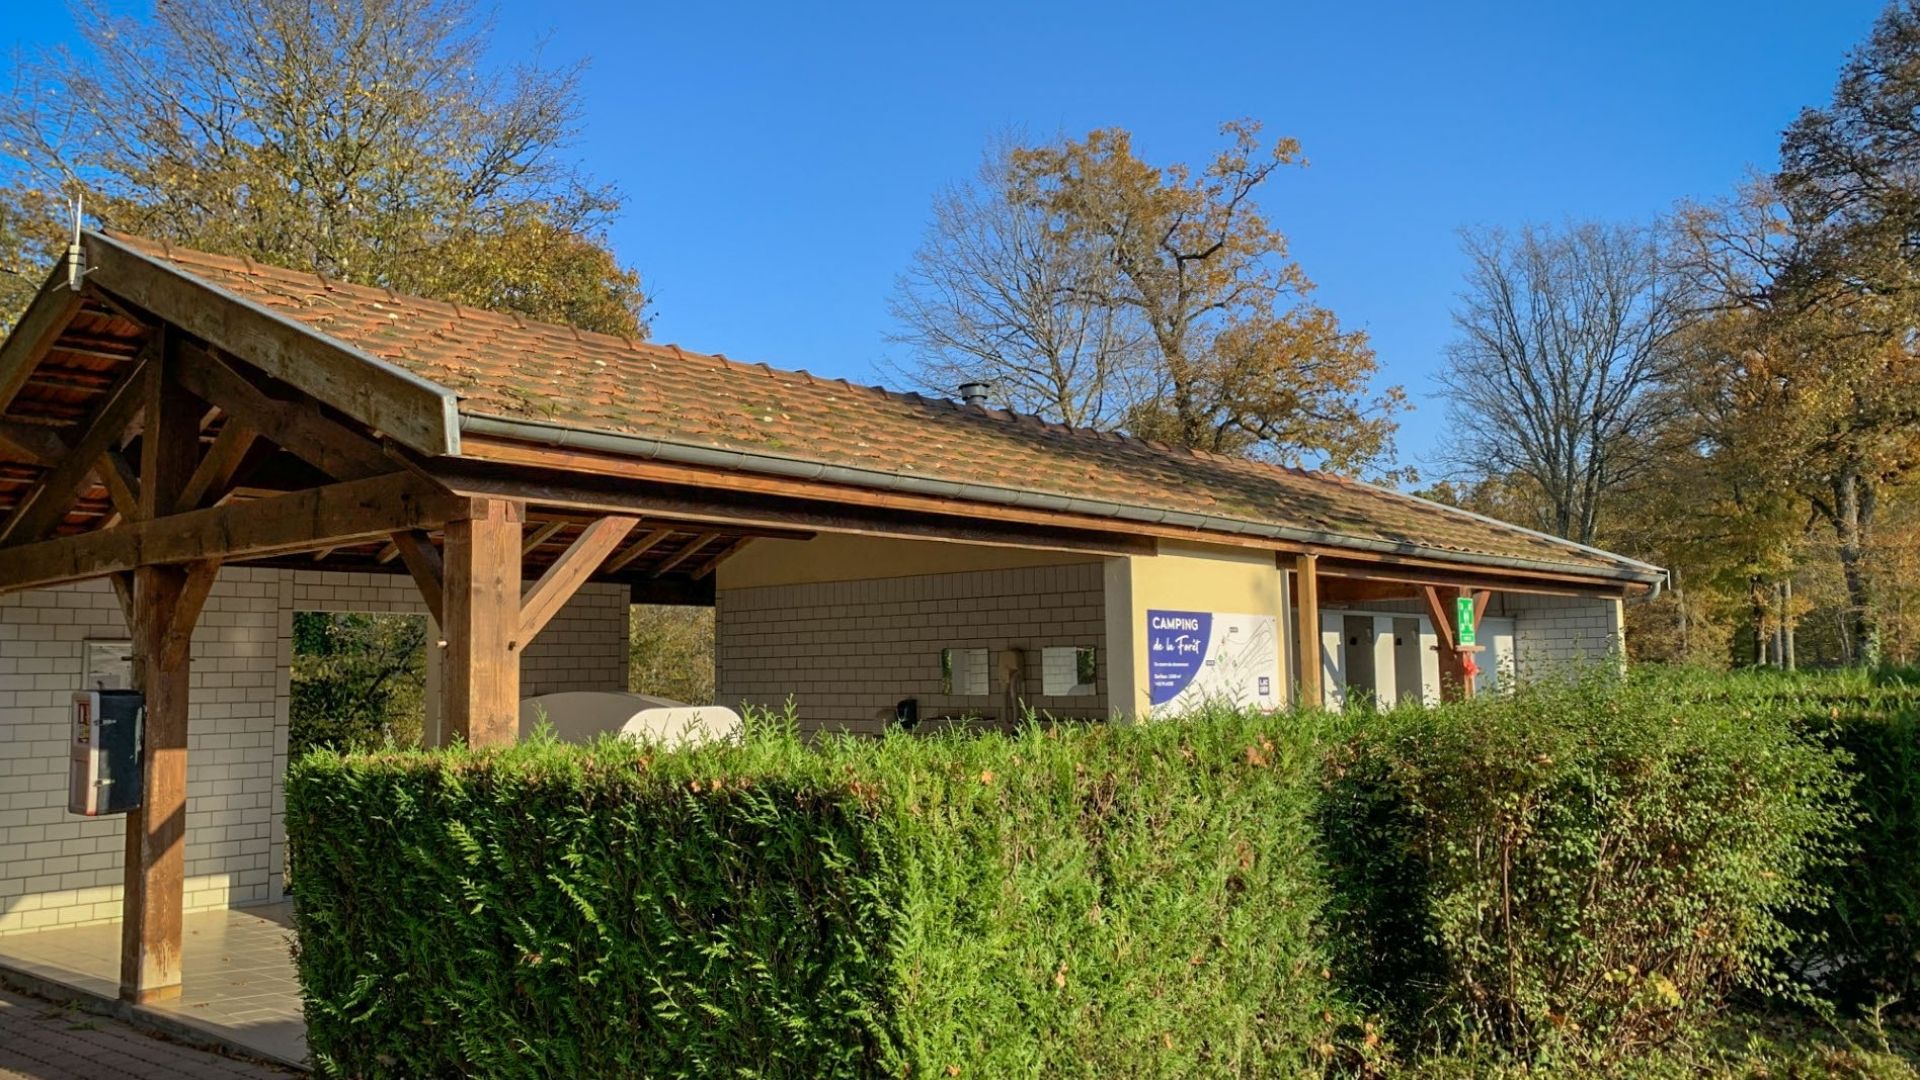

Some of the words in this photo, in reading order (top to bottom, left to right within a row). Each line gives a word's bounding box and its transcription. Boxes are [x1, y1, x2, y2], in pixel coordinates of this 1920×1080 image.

[1152, 617, 1198, 631] CAMPING
[1153, 637, 1164, 651] de
[1166, 637, 1175, 651] la
[1175, 635, 1201, 655] Forêt
